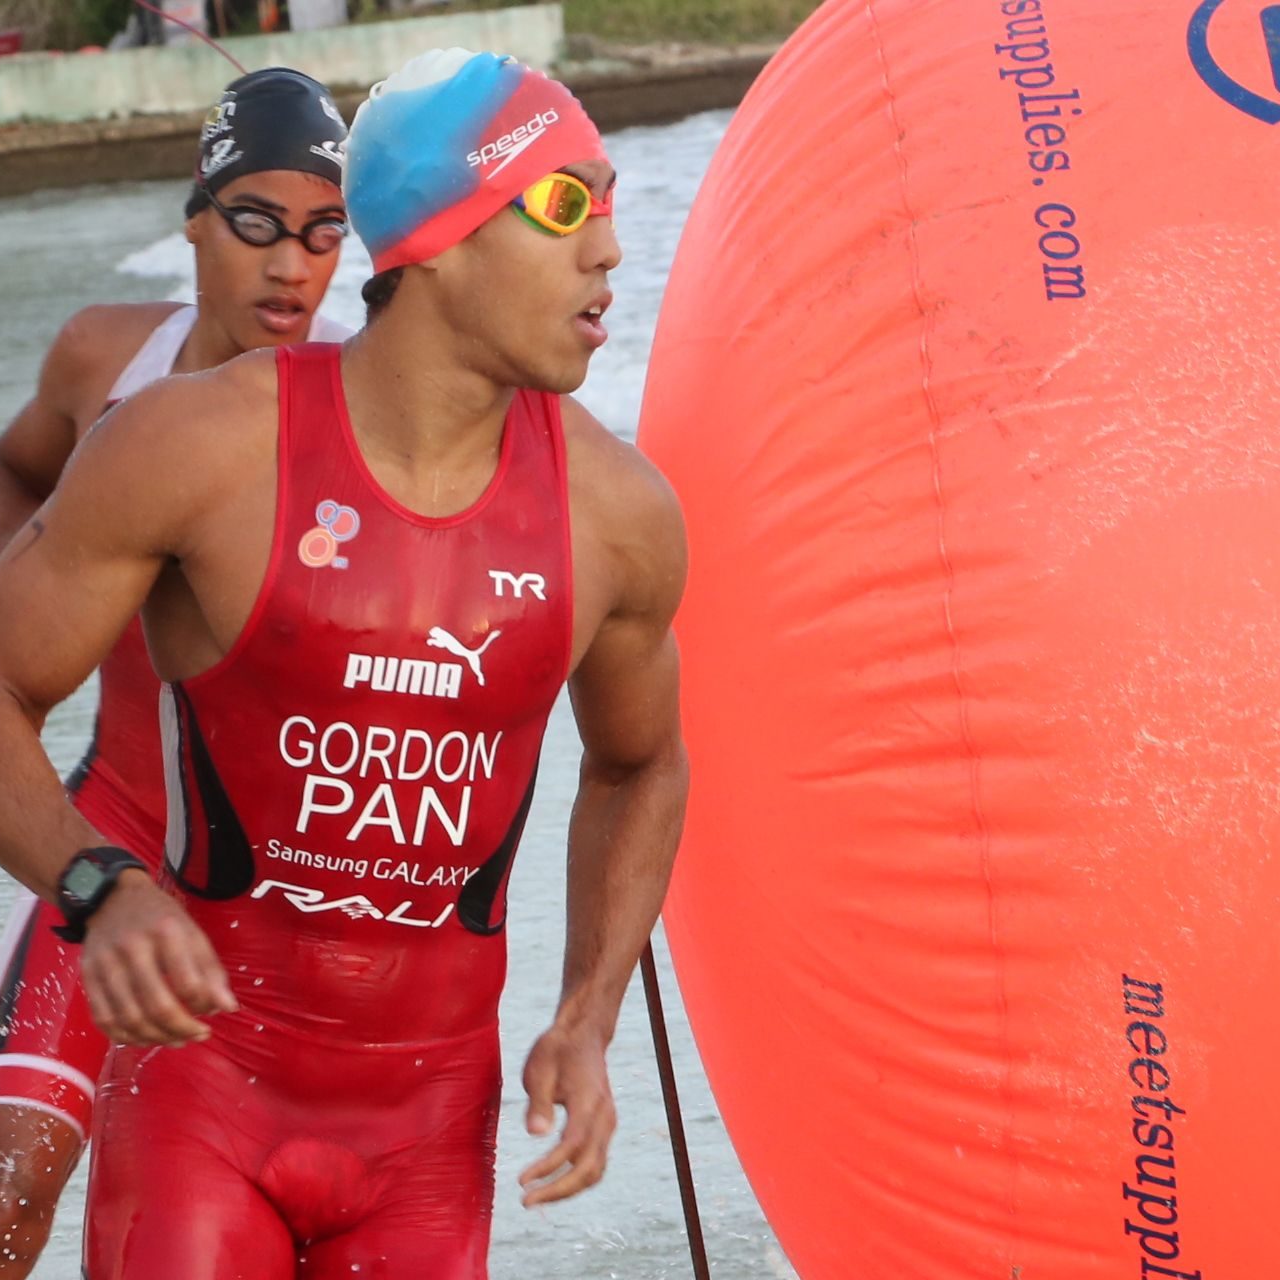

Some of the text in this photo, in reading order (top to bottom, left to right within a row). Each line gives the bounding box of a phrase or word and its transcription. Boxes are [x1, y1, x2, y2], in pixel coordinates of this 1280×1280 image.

[466, 109, 560, 167] speedo
[488, 569, 547, 600] TYR
[343, 653, 463, 699] PUMA
[278, 715, 503, 784] GORDON
[296, 773, 472, 847] PAN
[266, 838, 480, 887] Samsung GALAXY
